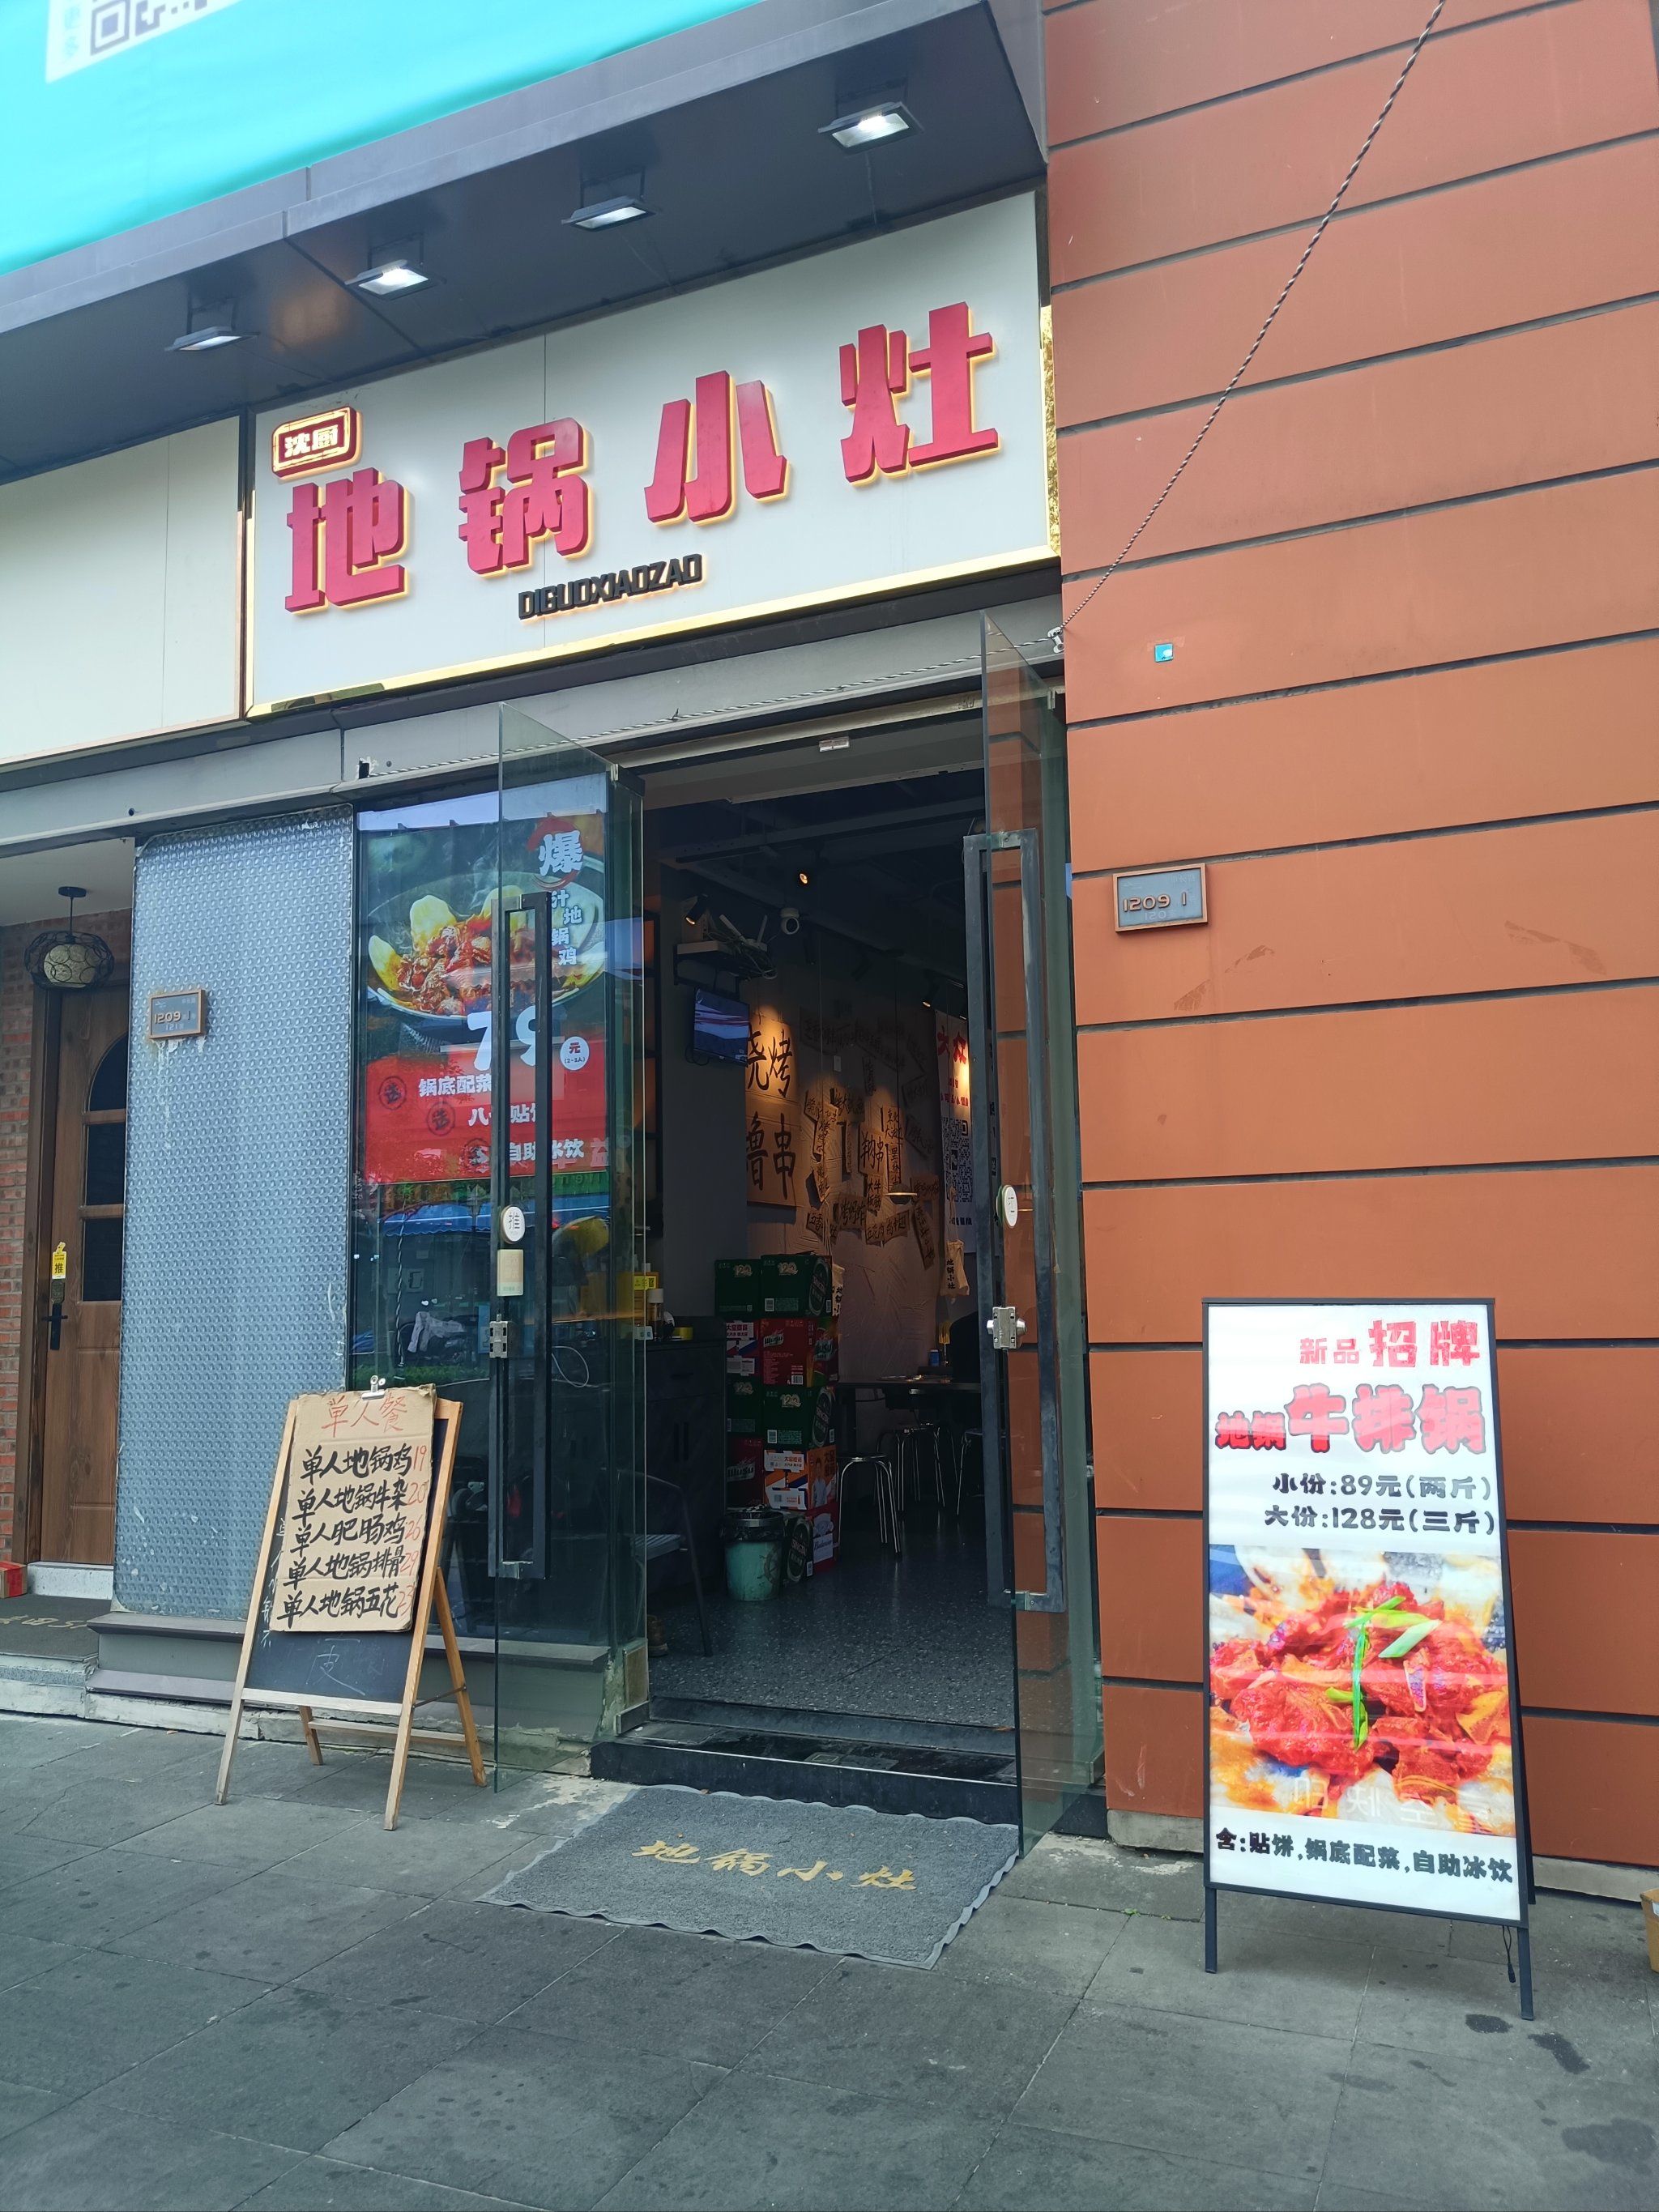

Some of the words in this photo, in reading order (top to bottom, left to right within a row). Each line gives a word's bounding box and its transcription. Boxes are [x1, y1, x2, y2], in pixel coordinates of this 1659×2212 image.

[285, 301, 1000, 613] 地锅小灶
[518, 553, 704, 620] DIGUOXIAOZAO
[1123, 893, 1171, 913] 1209
[154, 1010, 182, 1025] 1209
[569, 1042, 582, 1055] 元
[321, 1395, 407, 1438] 单人餐
[300, 1443, 412, 1485] 单人地锅鸡
[1272, 1473, 1491, 1501] 小份:89元(两斤)
[290, 1511, 407, 1558] 单人肥肠鸡
[1264, 1504, 1495, 1535] 大份:128元(三斤)
[284, 1545, 406, 1590] 单人地锅排骨
[276, 1583, 400, 1629] 单人地锅五花
